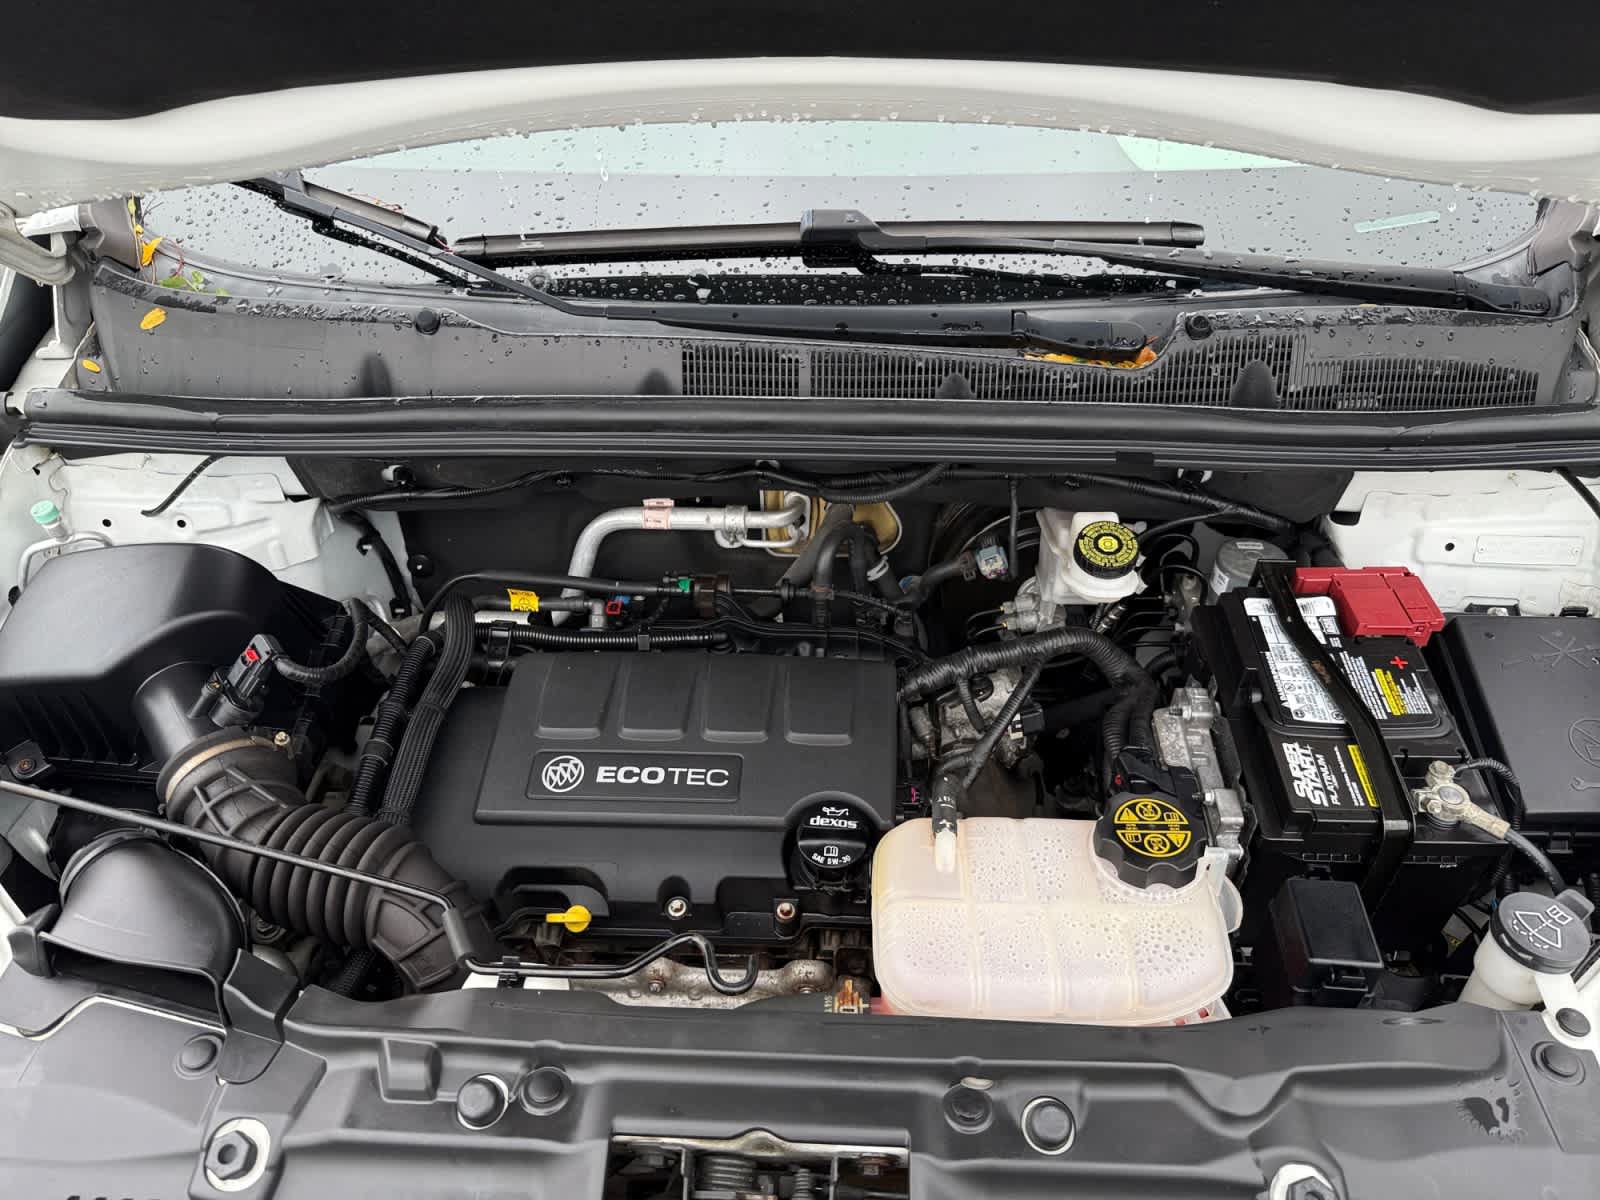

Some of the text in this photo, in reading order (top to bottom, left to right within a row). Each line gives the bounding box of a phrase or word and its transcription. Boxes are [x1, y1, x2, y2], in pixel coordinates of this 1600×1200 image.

[596, 765, 729, 787] ECOTEC
[1282, 742, 1306, 797] SUPER
[1297, 744, 1330, 807] START
[1315, 753, 1341, 806] PLATINUM
[809, 815, 859, 829] dexos
[811, 852, 826, 864] SAE
